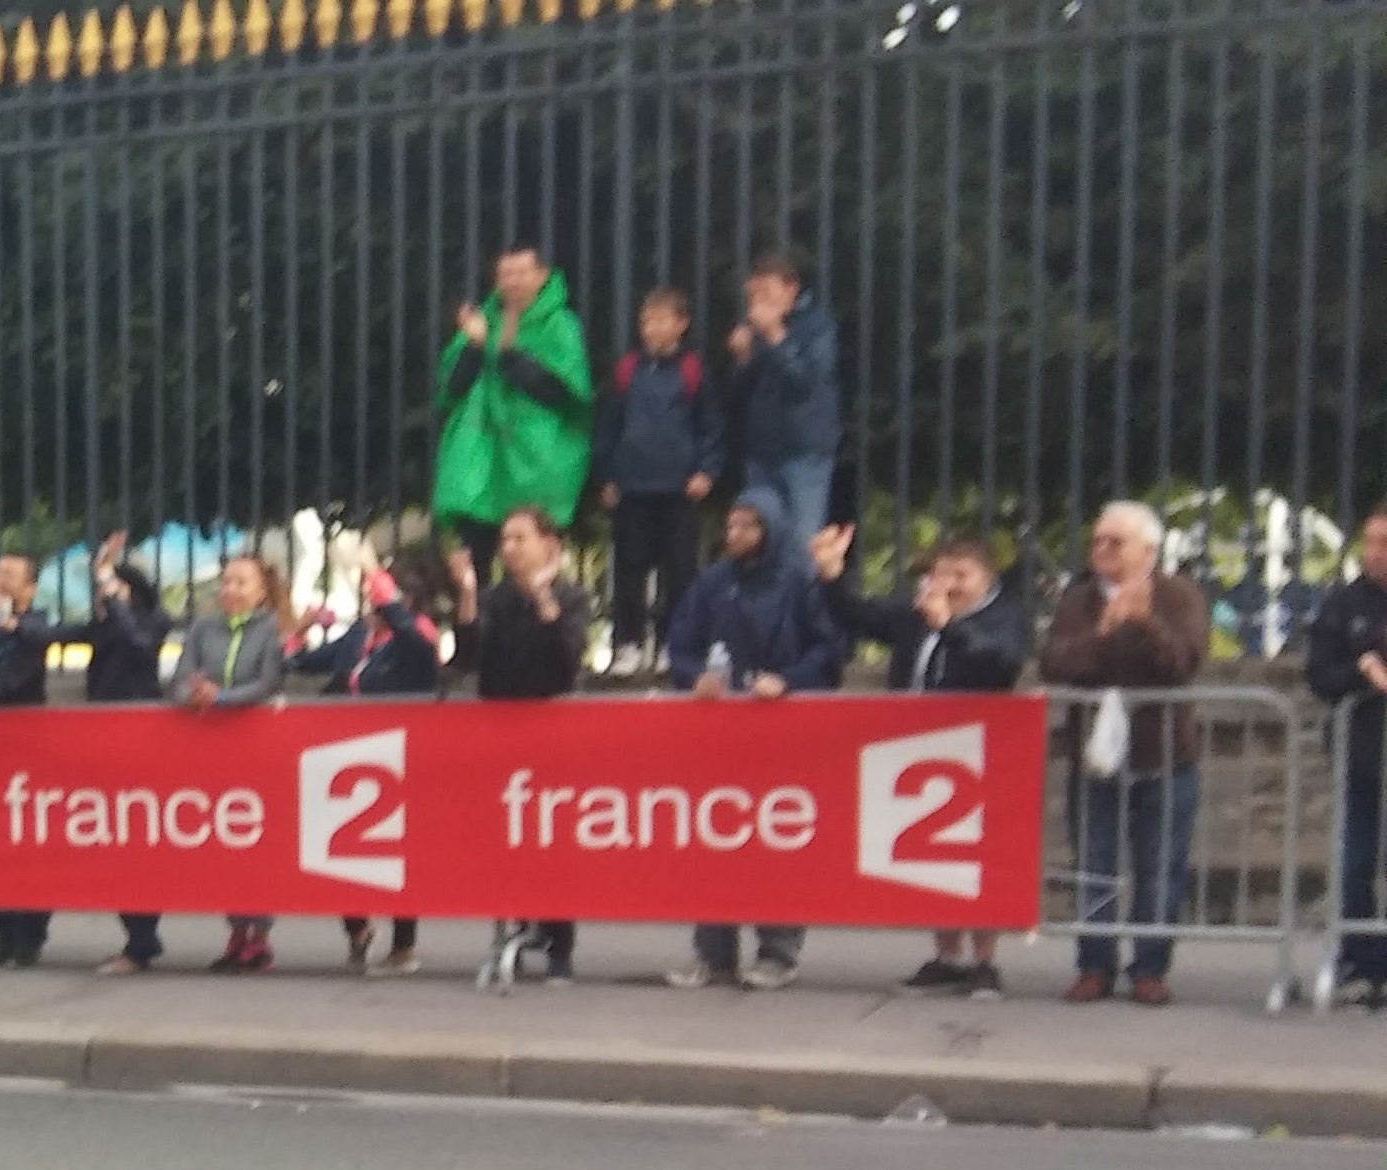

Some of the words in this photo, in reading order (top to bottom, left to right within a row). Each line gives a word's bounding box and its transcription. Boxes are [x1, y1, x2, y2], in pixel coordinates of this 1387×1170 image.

[3, 771, 265, 849] france
[327, 762, 406, 860] 2
[501, 768, 819, 851] france
[890, 757, 985, 863] 2
